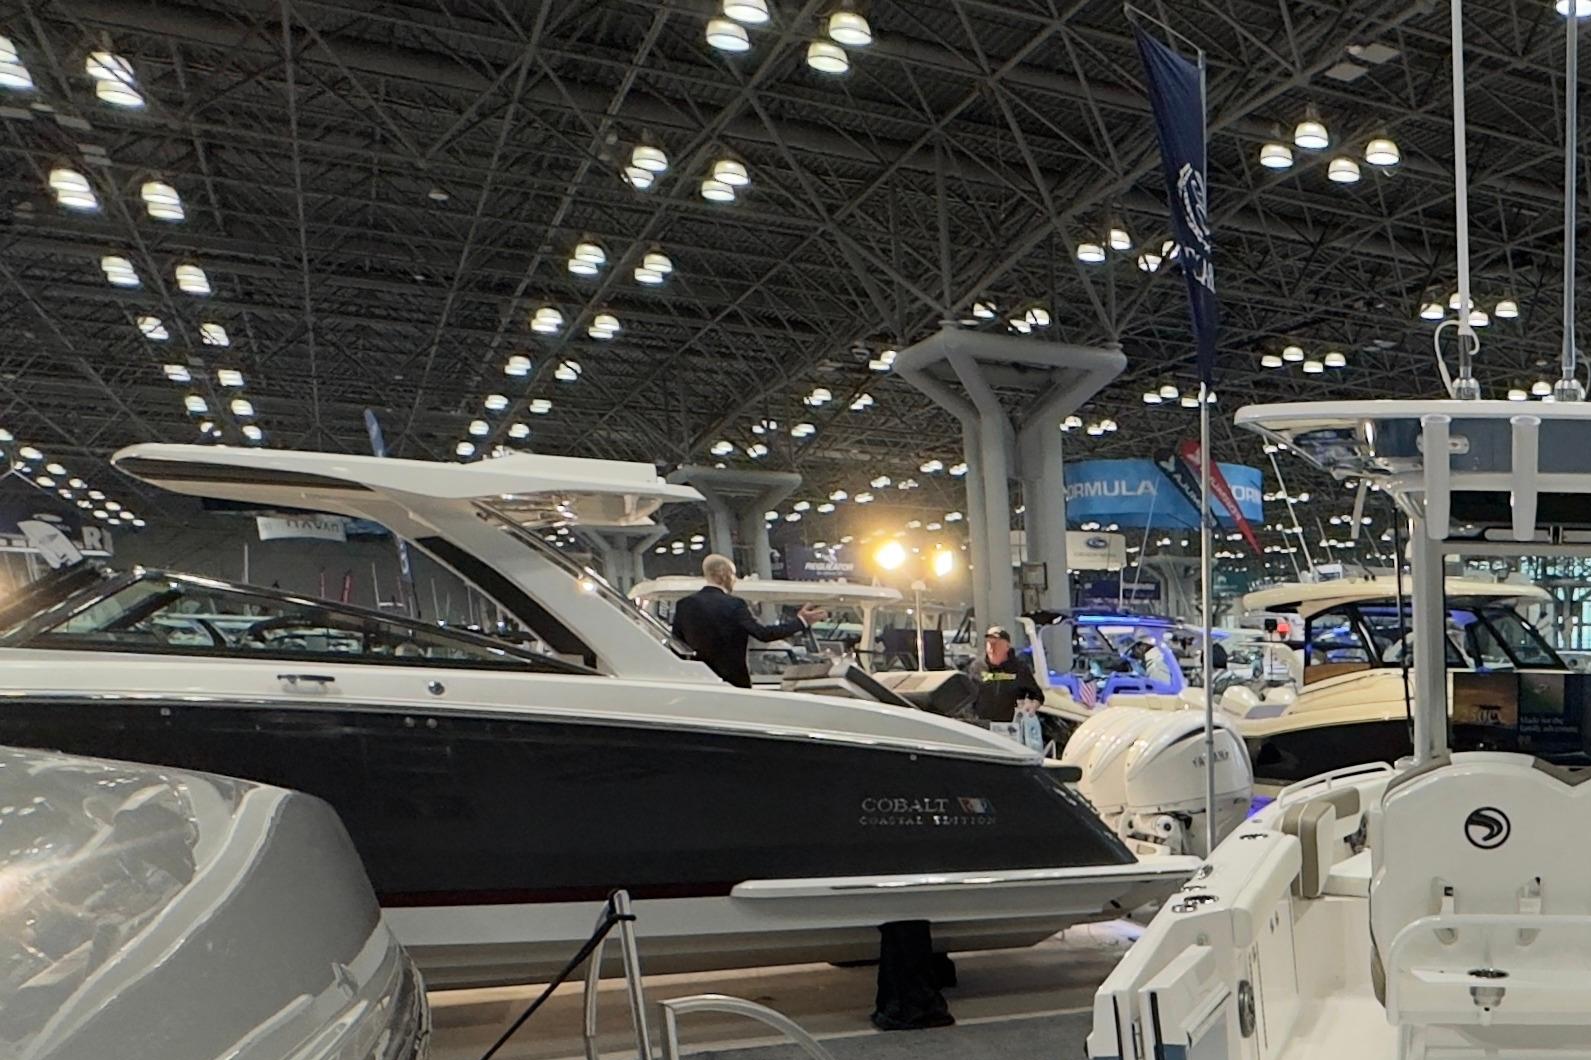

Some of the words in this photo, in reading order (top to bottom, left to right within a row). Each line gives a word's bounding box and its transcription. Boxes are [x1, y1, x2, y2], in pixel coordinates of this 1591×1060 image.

[860, 798, 949, 812] COBALT
[858, 815, 924, 826] COASTAL
[932, 815, 997, 826] EDITION
